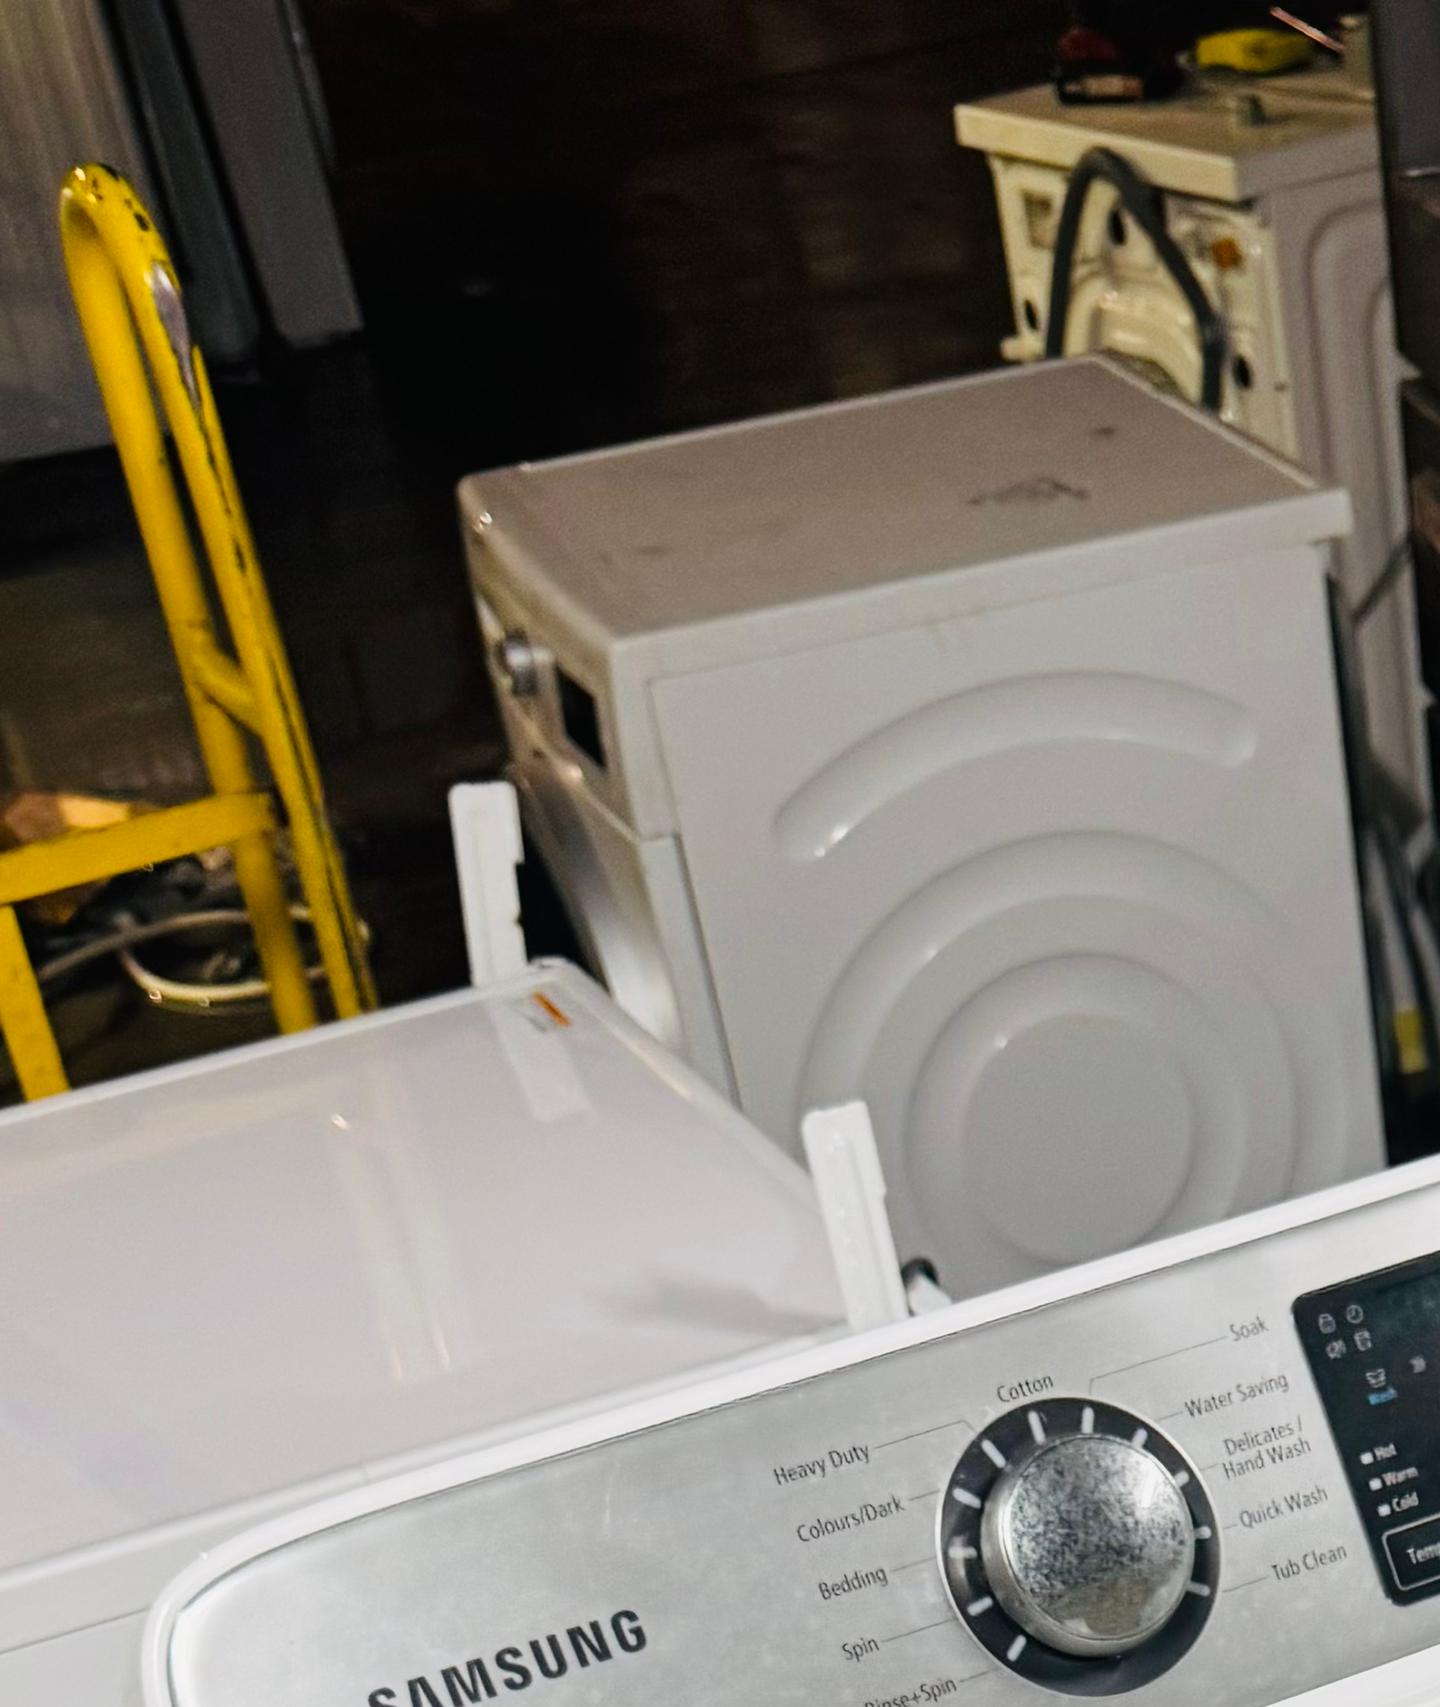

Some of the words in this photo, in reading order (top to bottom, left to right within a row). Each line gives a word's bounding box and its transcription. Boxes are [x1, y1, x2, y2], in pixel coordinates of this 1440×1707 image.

[1229, 1315, 1269, 1343] Soak
[996, 1372, 1054, 1402] Cotton
[1184, 1387, 1233, 1419] Water
[1232, 1372, 1289, 1407] Saving
[1224, 1424, 1296, 1455] Delicates
[1374, 1442, 1397, 1460] Hot
[774, 1453, 830, 1486] Heavy
[828, 1442, 871, 1476] Duty
[1222, 1448, 1266, 1479] Hand
[1265, 1438, 1311, 1467] Wash
[1382, 1466, 1419, 1486] Warm
[1240, 1498, 1283, 1529] Quick
[1282, 1485, 1328, 1515] Wash
[1392, 1491, 1419, 1512] Cold
[797, 1498, 905, 1544] Colours/Dark
[1271, 1556, 1302, 1582] Tub
[1301, 1542, 1348, 1575] Clean
[818, 1565, 889, 1601] Bedding
[841, 1635, 880, 1662] Spin
